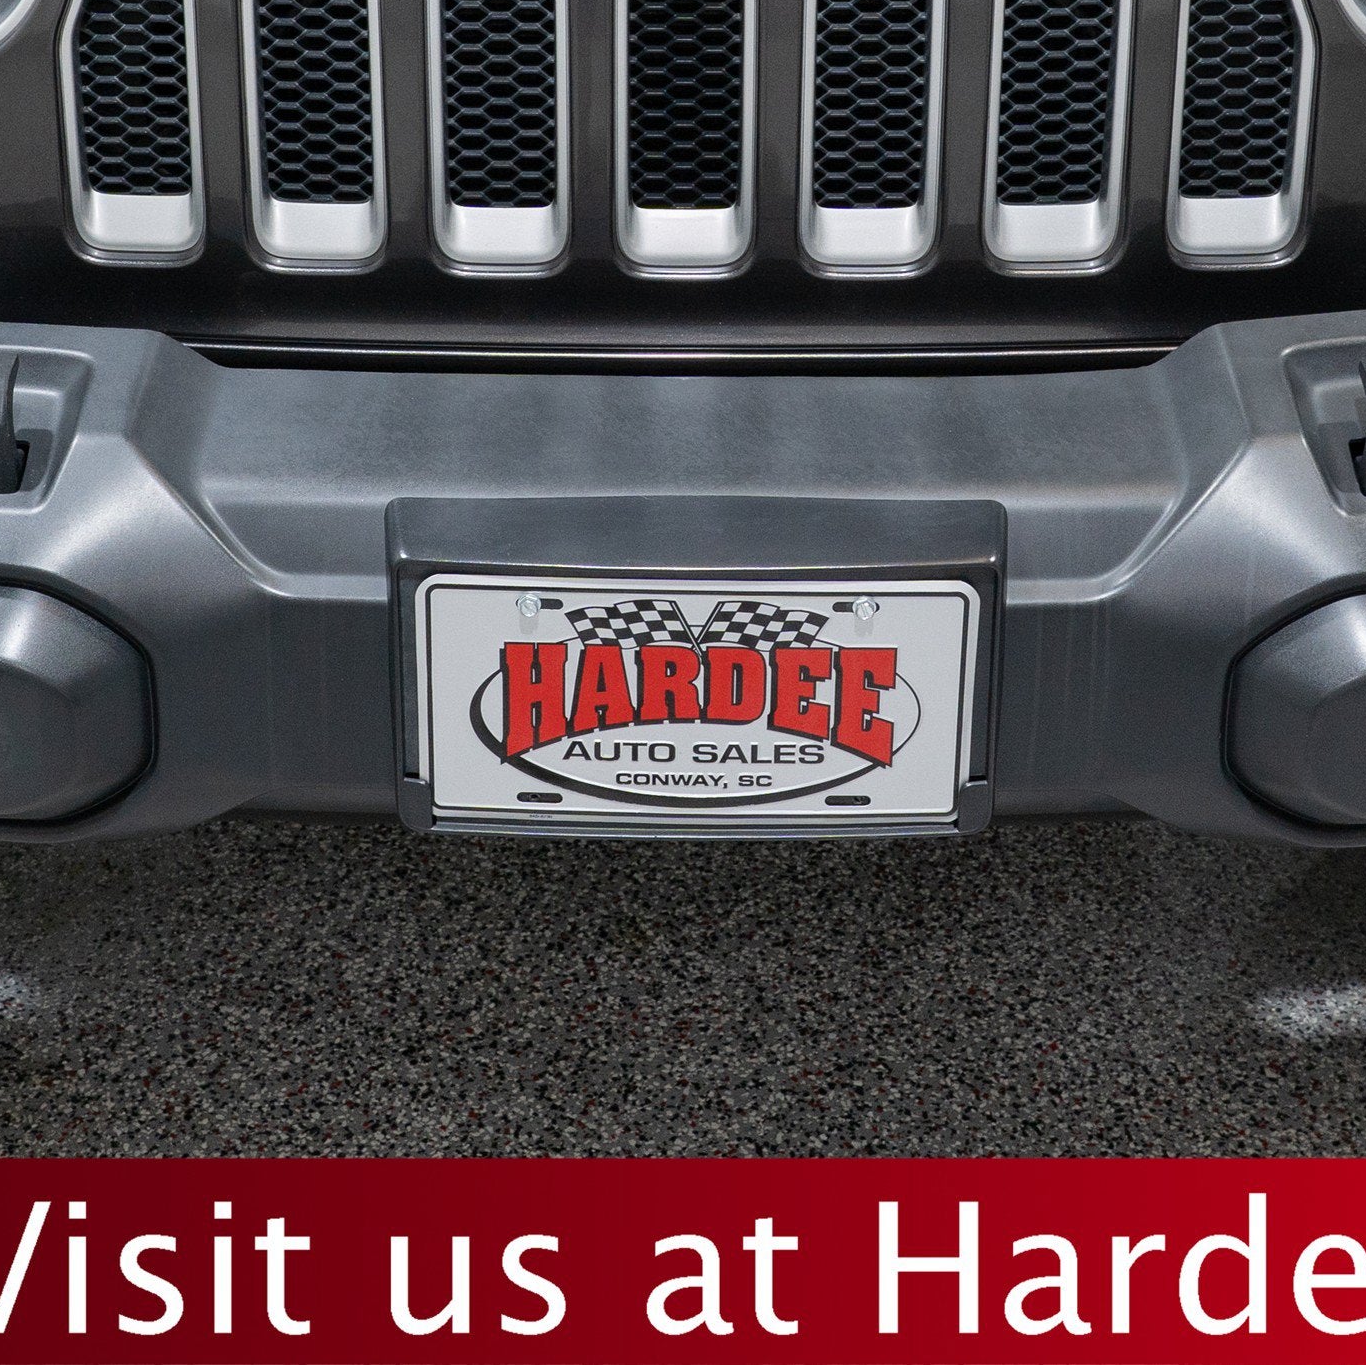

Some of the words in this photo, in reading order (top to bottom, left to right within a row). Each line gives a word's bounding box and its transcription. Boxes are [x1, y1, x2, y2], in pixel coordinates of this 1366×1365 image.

[501, 641, 899, 768] HARDEE
[562, 740, 676, 762] AUTO
[692, 744, 825, 764] SALES
[615, 772, 729, 789] CONWAY,
[738, 774, 773, 787] SC
